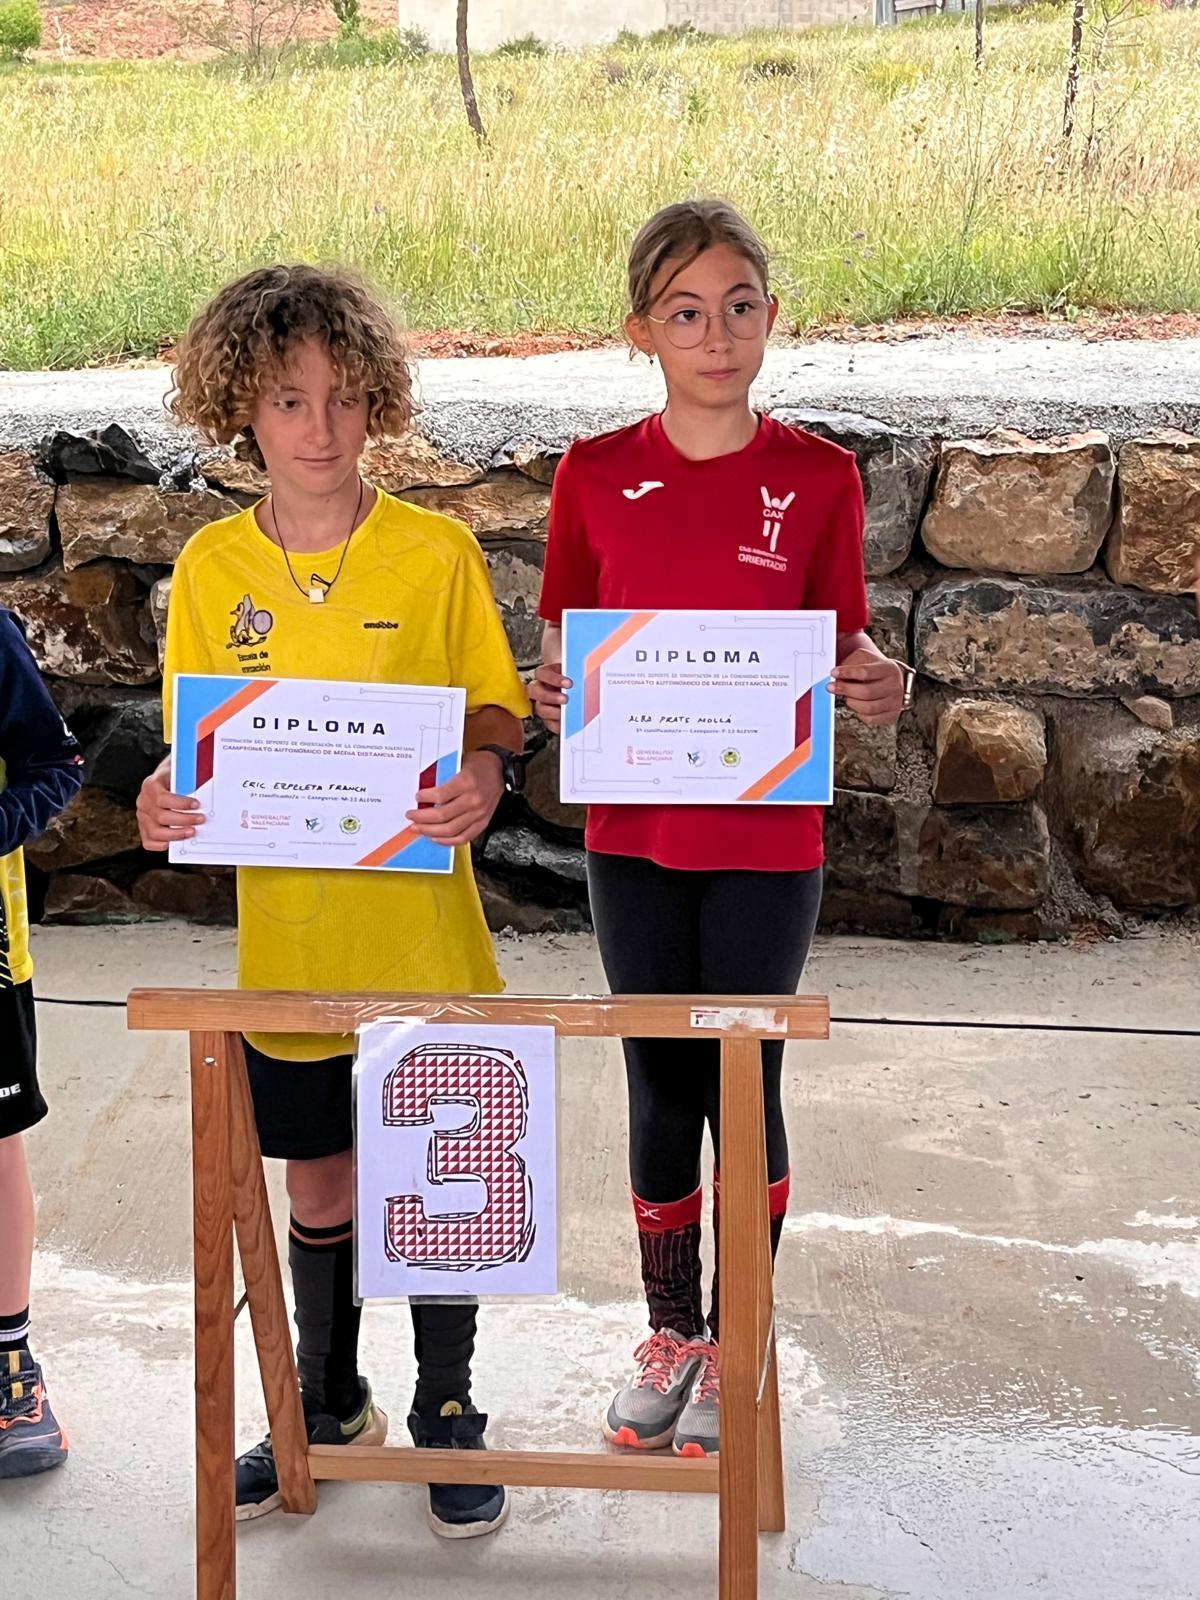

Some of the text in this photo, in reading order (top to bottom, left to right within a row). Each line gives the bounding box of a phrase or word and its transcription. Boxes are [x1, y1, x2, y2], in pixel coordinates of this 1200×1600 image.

[763, 508, 784, 520] CAX
[259, 650, 268, 659] de
[635, 650, 761, 663] DIPLOMA
[628, 715, 652, 723] ALBA
[253, 716, 386, 735] DIPLOMA
[222, 744, 273, 752] CAMPEONATO
[242, 780, 266, 789] ERIC
[328, 783, 367, 793] FRANCH
[383, 1043, 537, 1272] 3
